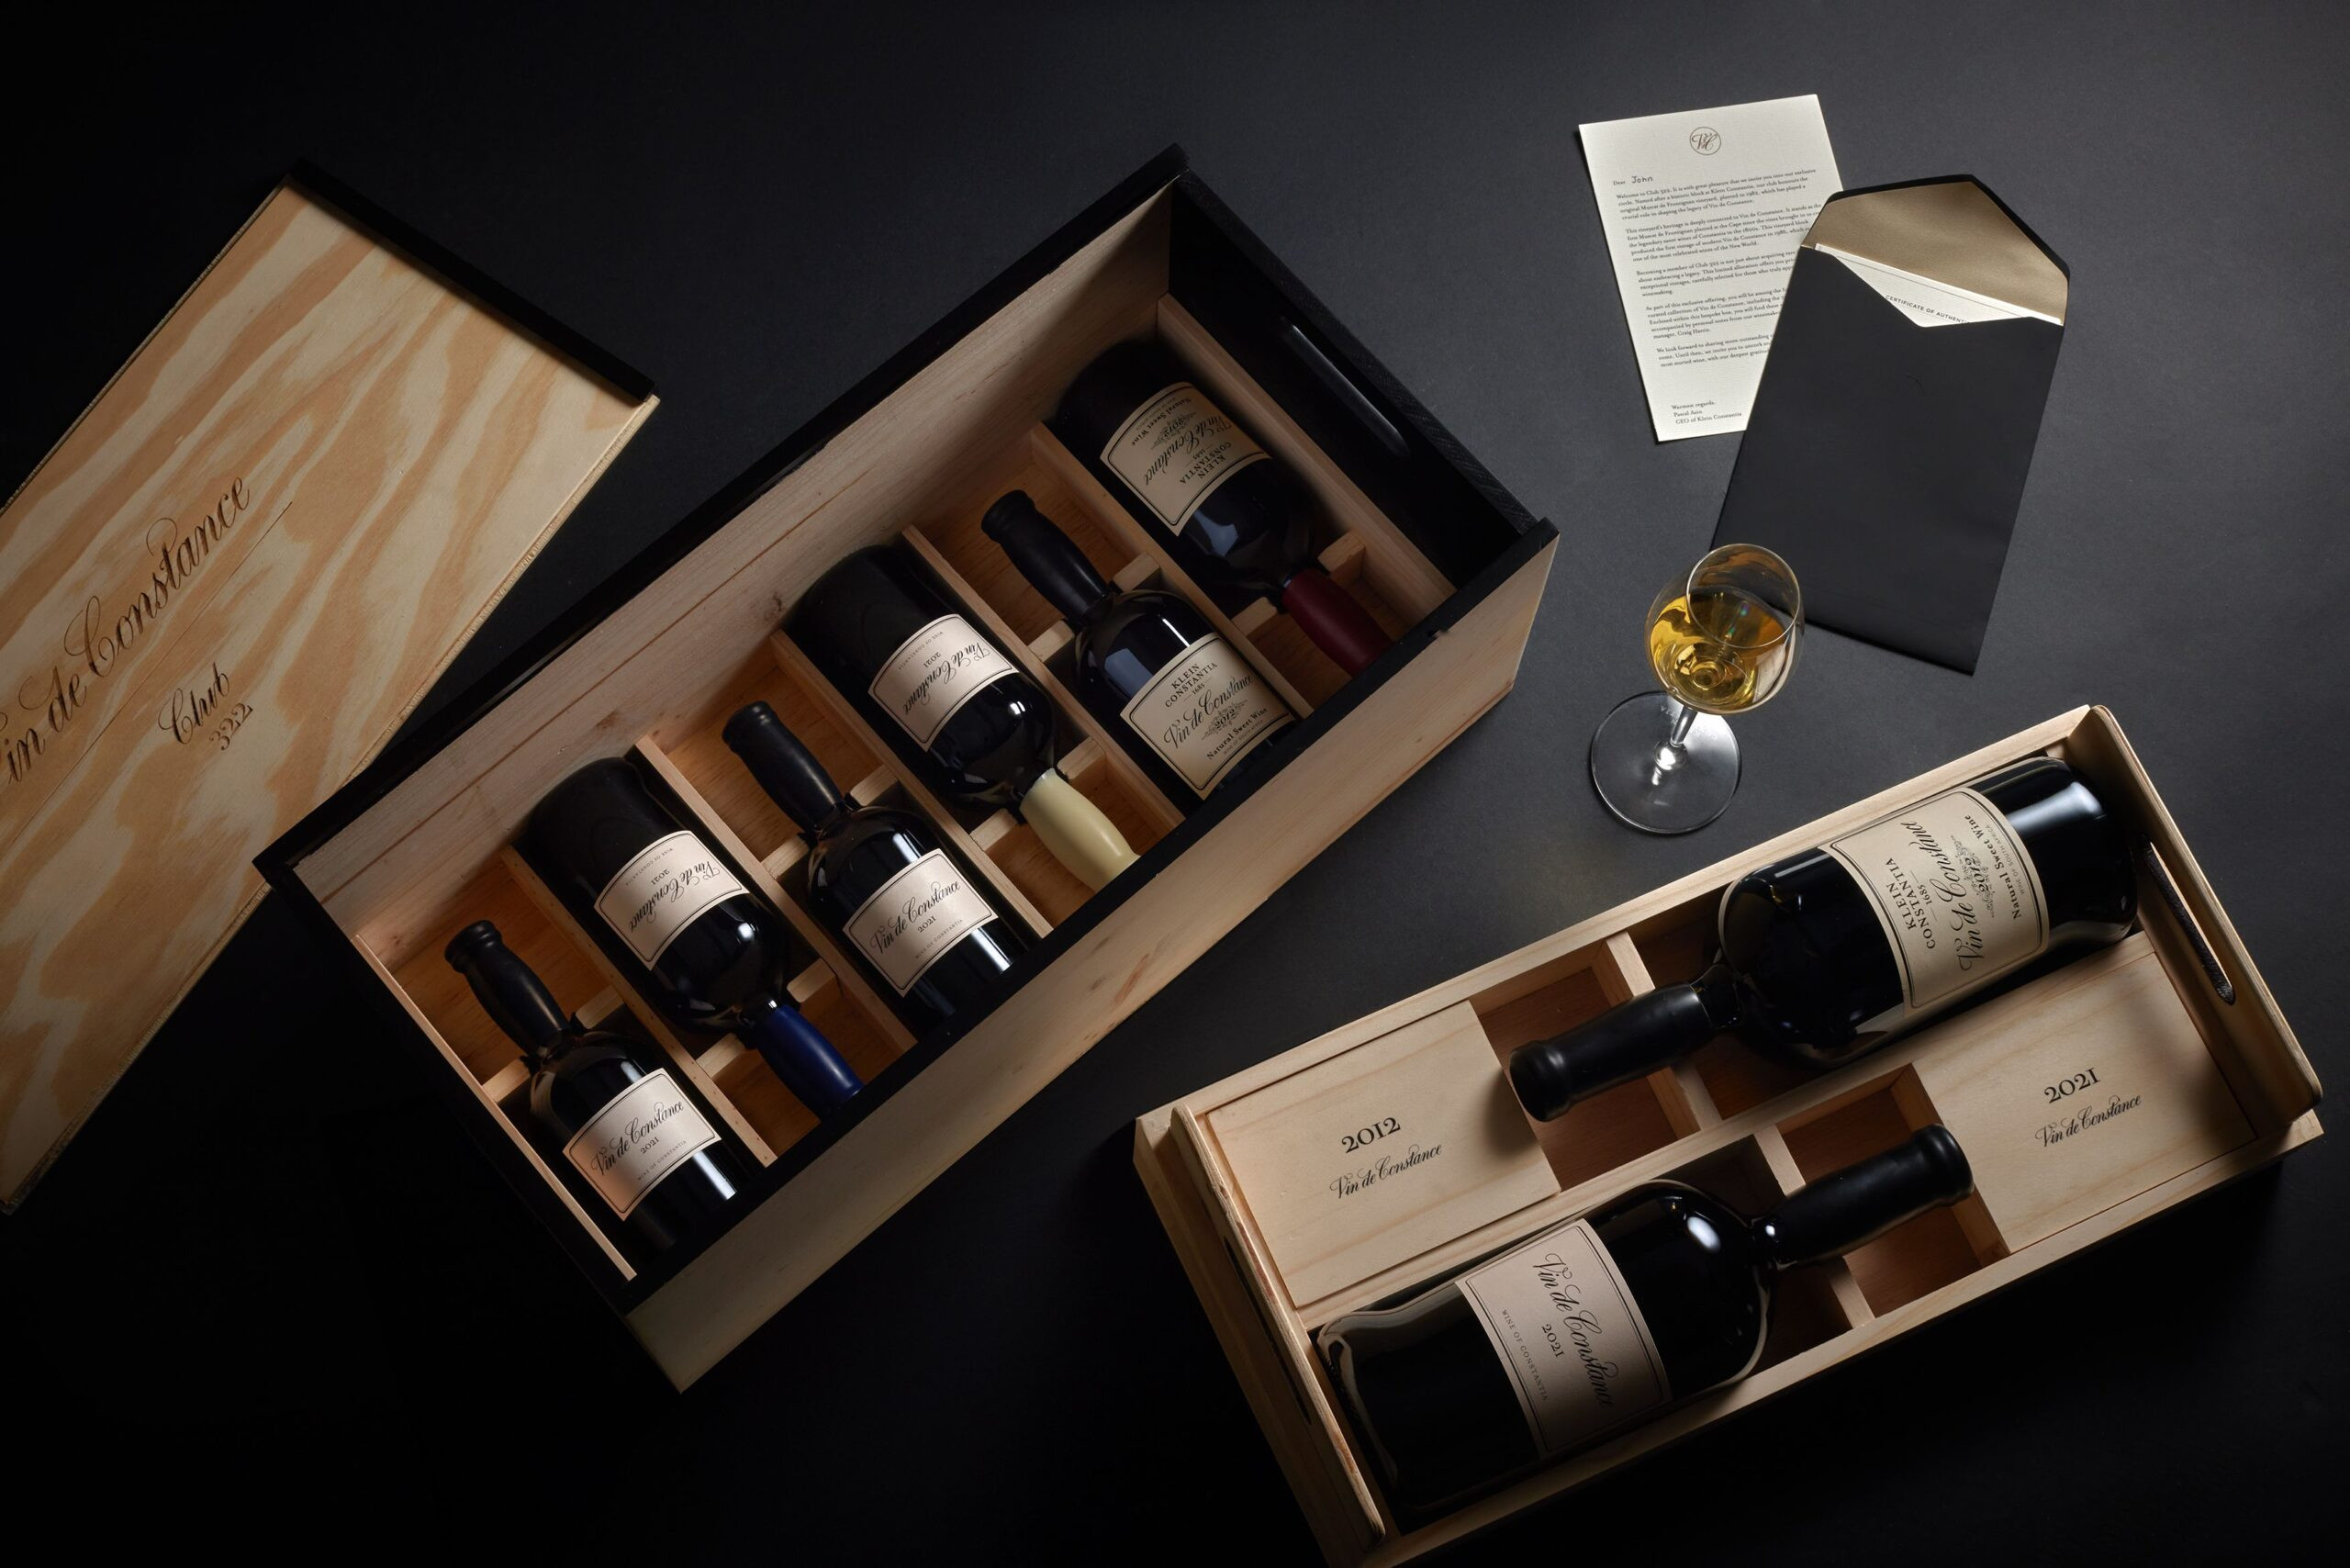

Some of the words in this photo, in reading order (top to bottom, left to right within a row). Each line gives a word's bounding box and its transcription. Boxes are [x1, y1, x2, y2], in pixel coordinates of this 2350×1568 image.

[1631, 175, 1653, 184] John
[1619, 206, 1640, 214] original
[1719, 192, 1739, 201] planted
[1785, 184, 1802, 192] played
[1885, 295, 1925, 311] CERTIFICATE
[1147, 412, 1167, 428] Sweet
[1168, 398, 1192, 413] Natural
[1130, 430, 1148, 446] Wine
[1163, 420, 1184, 437] 2012
[1196, 425, 1214, 439] de
[1208, 416, 1232, 433] Vin
[1144, 431, 1200, 486] Constance
[1180, 442, 1232, 484] CONSTANTIA
[1198, 455, 1225, 479] KLEIN
[63, 477, 250, 677] Constance
[923, 652, 941, 668] 2021
[952, 653, 970, 667] de
[965, 643, 990, 661] Vin
[903, 661, 957, 715] Constance
[1165, 662, 1218, 708] CONSTANTIA
[1171, 663, 1200, 690] KLEIN
[1192, 683, 1205, 695] 1685
[18, 666, 86, 733] de
[158, 662, 229, 745] Club
[1164, 719, 1190, 749] Vin
[1183, 708, 1203, 731] de
[1198, 674, 1254, 716] Constance
[210, 702, 253, 751] 322
[1207, 734, 1234, 760] Natural
[1233, 719, 1253, 735] Sweet
[1250, 707, 1268, 722] Wine
[1214, 709, 1236, 730] 2012
[0, 712, 45, 784] in
[1964, 814, 1984, 839] Wine
[1986, 823, 2003, 847] AFRICA
[1900, 822, 1966, 902] Constance
[1984, 838, 2005, 870] Sweet
[2002, 846, 2016, 868] SOUTH
[651, 868, 670, 885] 2021
[680, 868, 700, 886] de
[694, 861, 721, 880] Vin
[1964, 857, 1989, 892] 2012
[1918, 885, 1932, 905] 1685
[1999, 872, 2021, 920] Natural
[2012, 878, 2025, 896] WINE
[630, 882, 685, 933] Constance
[869, 925, 894, 954] Vin
[888, 915, 907, 936] de
[902, 880, 960, 923] Constance
[1884, 857, 1936, 949] CONSTANTIA
[1886, 883, 1917, 931] KLEIN
[1951, 902, 1977, 931] de
[918, 915, 936, 934] 2021
[1954, 930, 1985, 971] Vin
[2044, 1068, 2100, 1103] 2021
[1342, 1117, 1401, 1154] 2012
[2035, 1122, 2065, 1148] Vin
[2061, 1117, 2079, 1137] de
[2077, 1094, 2141, 1130] Constance
[590, 1146, 616, 1176] Vin
[610, 1137, 630, 1158] de
[625, 1101, 684, 1144] Constance
[640, 1137, 660, 1154] 2021
[1329, 1173, 1359, 1199] Vin
[1358, 1168, 1376, 1189] de
[1375, 1144, 1442, 1181] Constance
[1533, 1253, 1572, 1290] Vin
[1550, 1284, 1581, 1312] de
[1542, 1324, 1564, 1358] 2021
[1564, 1309, 1618, 1408] Constance
